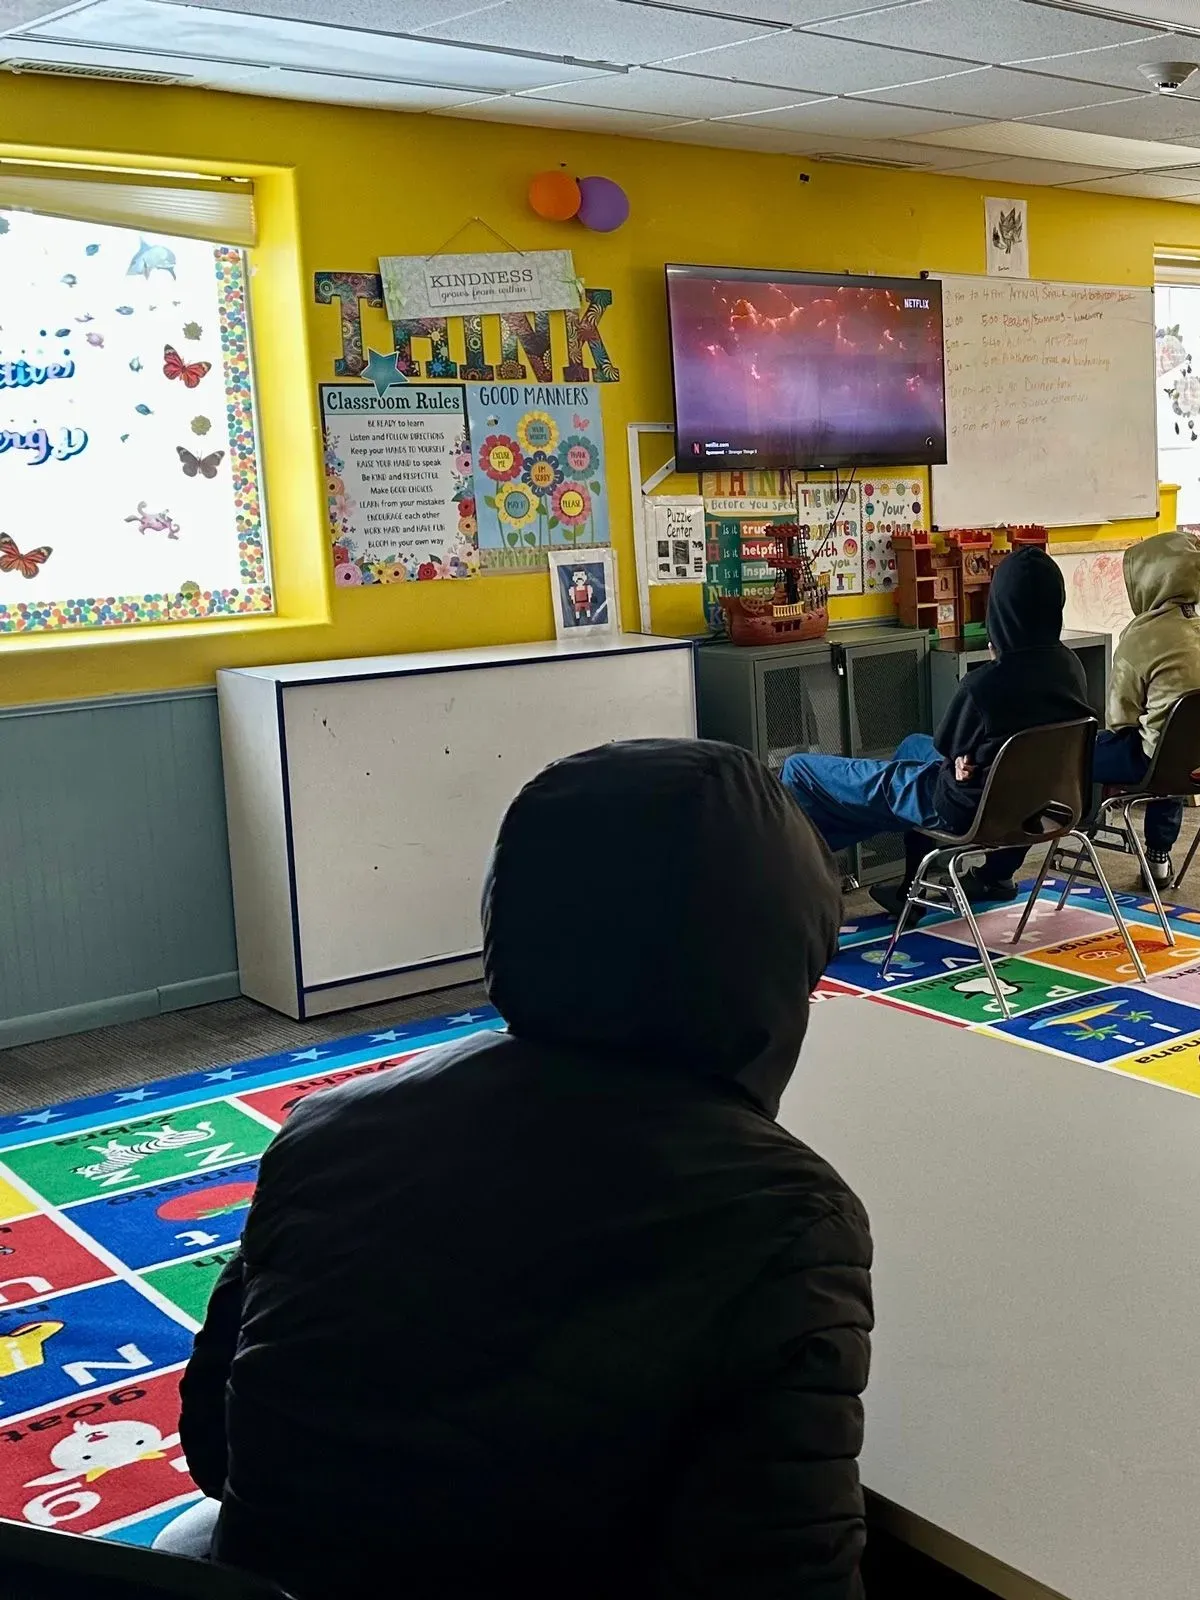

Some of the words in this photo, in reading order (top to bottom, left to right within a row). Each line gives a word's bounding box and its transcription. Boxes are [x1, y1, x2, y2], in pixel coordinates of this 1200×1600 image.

[430, 269, 534, 289] KINDNESS
[441, 288, 469, 300] grows
[472, 286, 496, 299] from
[498, 285, 528, 296] within
[904, 298, 930, 310] NETFLIX
[314, 271, 620, 383] THINK
[327, 391, 411, 410] Classroom
[416, 392, 460, 410] Rules
[480, 386, 519, 406] GOOD
[524, 387, 589, 406] MANNERS
[386, 432, 408, 440] FOLLOW
[410, 432, 445, 440] DIRECTIONS
[350, 446, 368, 456] Keep
[369, 448, 384, 456] your
[385, 446, 407, 454] HANDS
[418, 446, 445, 454] YOURSELF
[693, 442, 700, 454] N
[370, 486, 389, 495] Make
[408, 486, 433, 494] CHOICES
[801, 488, 822, 508] THE
[823, 488, 857, 506] WORLD
[360, 500, 380, 509] LEARN
[381, 500, 398, 508] from
[400, 500, 415, 509] your
[416, 498, 446, 506] mistakes
[562, 500, 581, 508] PLEASE
[711, 500, 746, 511] Before
[882, 502, 905, 517] Your
[367, 513, 403, 522] ENCOURAGE
[666, 508, 692, 523] Puzzle
[826, 508, 835, 520] is
[666, 524, 693, 538] Center
[706, 521, 721, 540] T
[722, 525, 730, 535] Is
[800, 520, 858, 541] BRIGHTER
[368, 540, 389, 549] BLOOM
[398, 540, 414, 548] your
[430, 538, 444, 546] way
[812, 542, 838, 558] with
[706, 544, 720, 562] H
[723, 548, 730, 558] Is
[710, 564, 719, 583] I
[724, 568, 732, 579] Is
[830, 558, 851, 577] you
[836, 572, 857, 590] IT
[708, 585, 722, 605] N
[942, 956, 982, 970] V
[901, 961, 1013, 996] pnguin
[1046, 984, 1080, 998] P
[1112, 1034, 1146, 1047] i
[296, 1059, 399, 1093] yacht
[54, 1115, 178, 1148] zebra
[184, 1142, 246, 1168] Z
[107, 1161, 258, 1206] omato
[61, 1343, 153, 1387] N
[0, 1386, 148, 1443] goat
[22, 1481, 103, 1526] g
